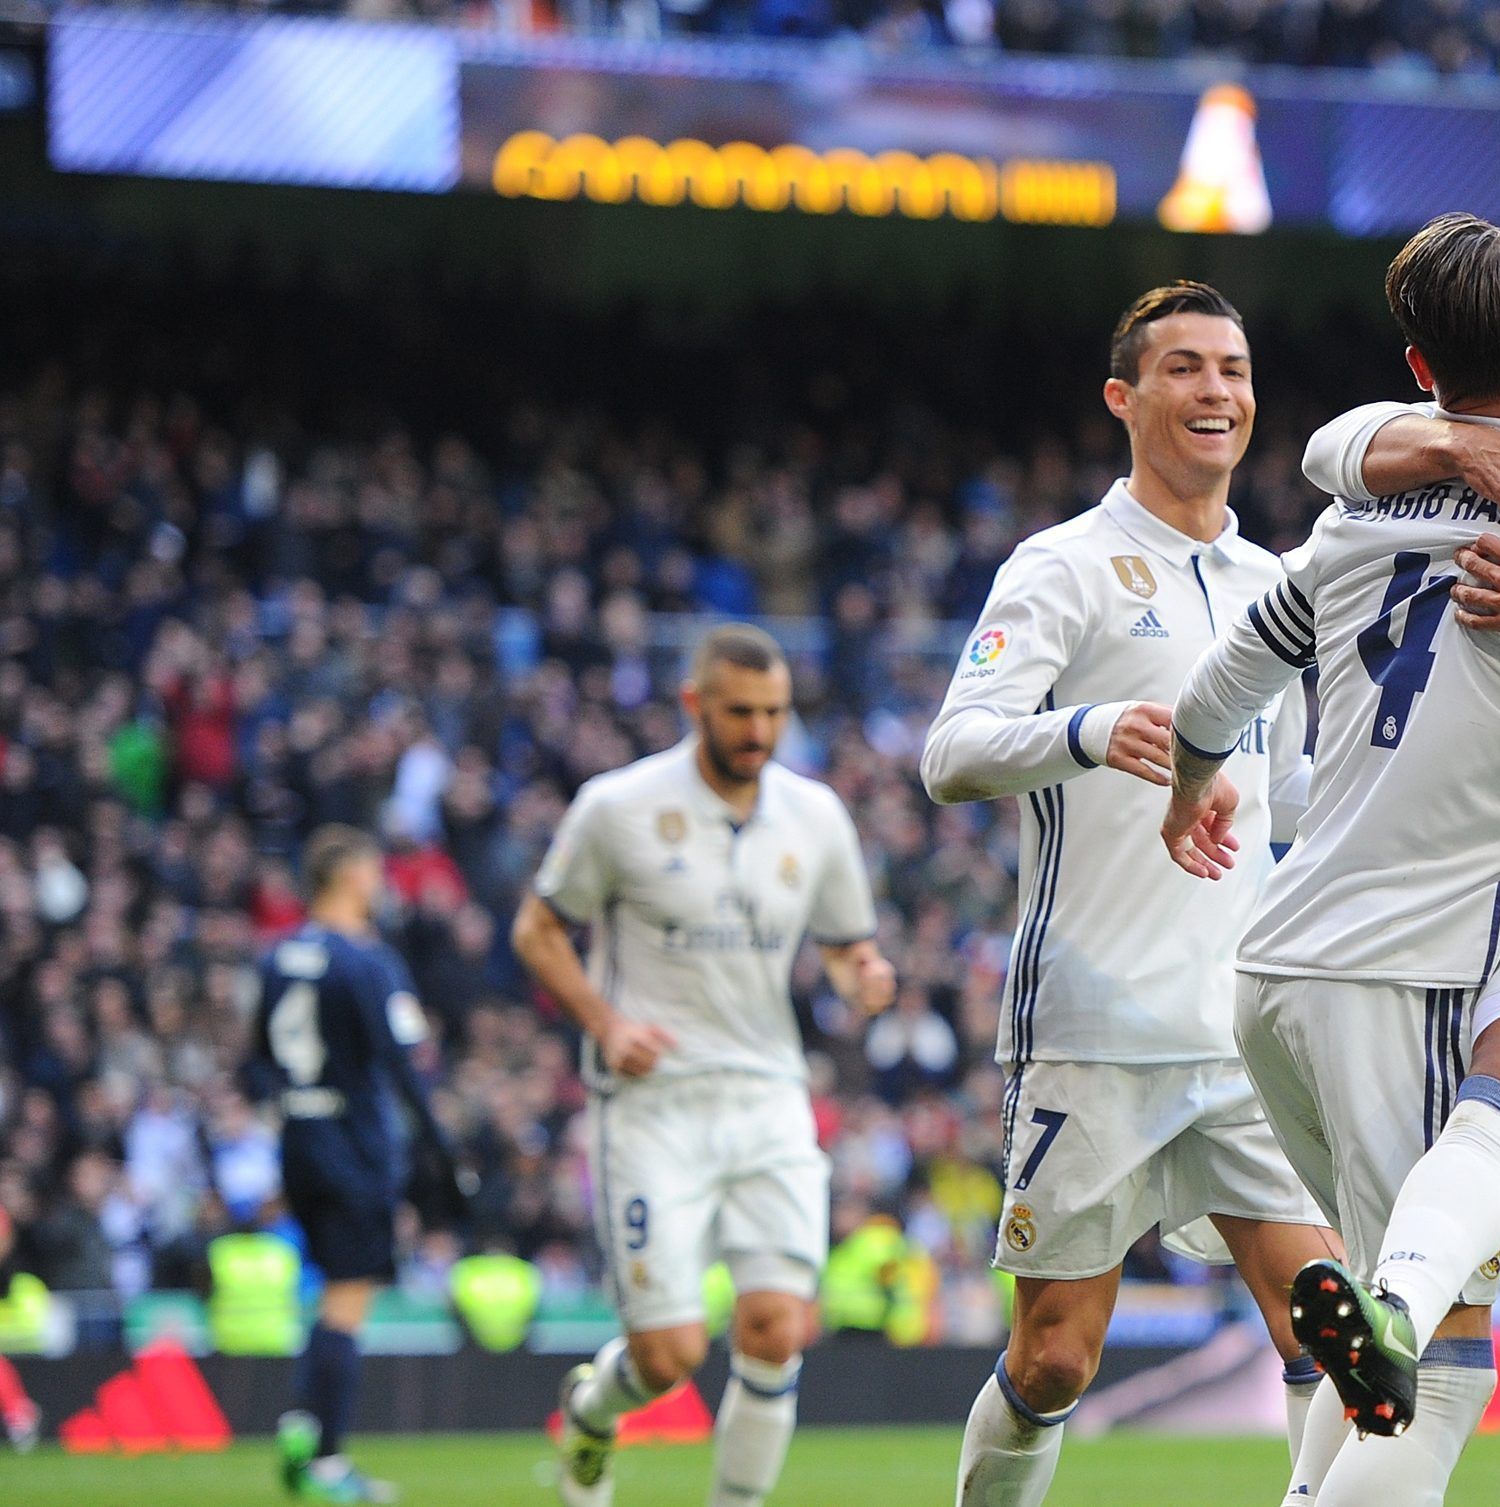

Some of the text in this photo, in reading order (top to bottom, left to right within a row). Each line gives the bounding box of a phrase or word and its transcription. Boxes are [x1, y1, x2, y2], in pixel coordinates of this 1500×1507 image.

[1129, 628, 1170, 638] adidas
[1356, 551, 1459, 751] 4
[1013, 1096, 1069, 1192] 7
[624, 1194, 650, 1252] 9
